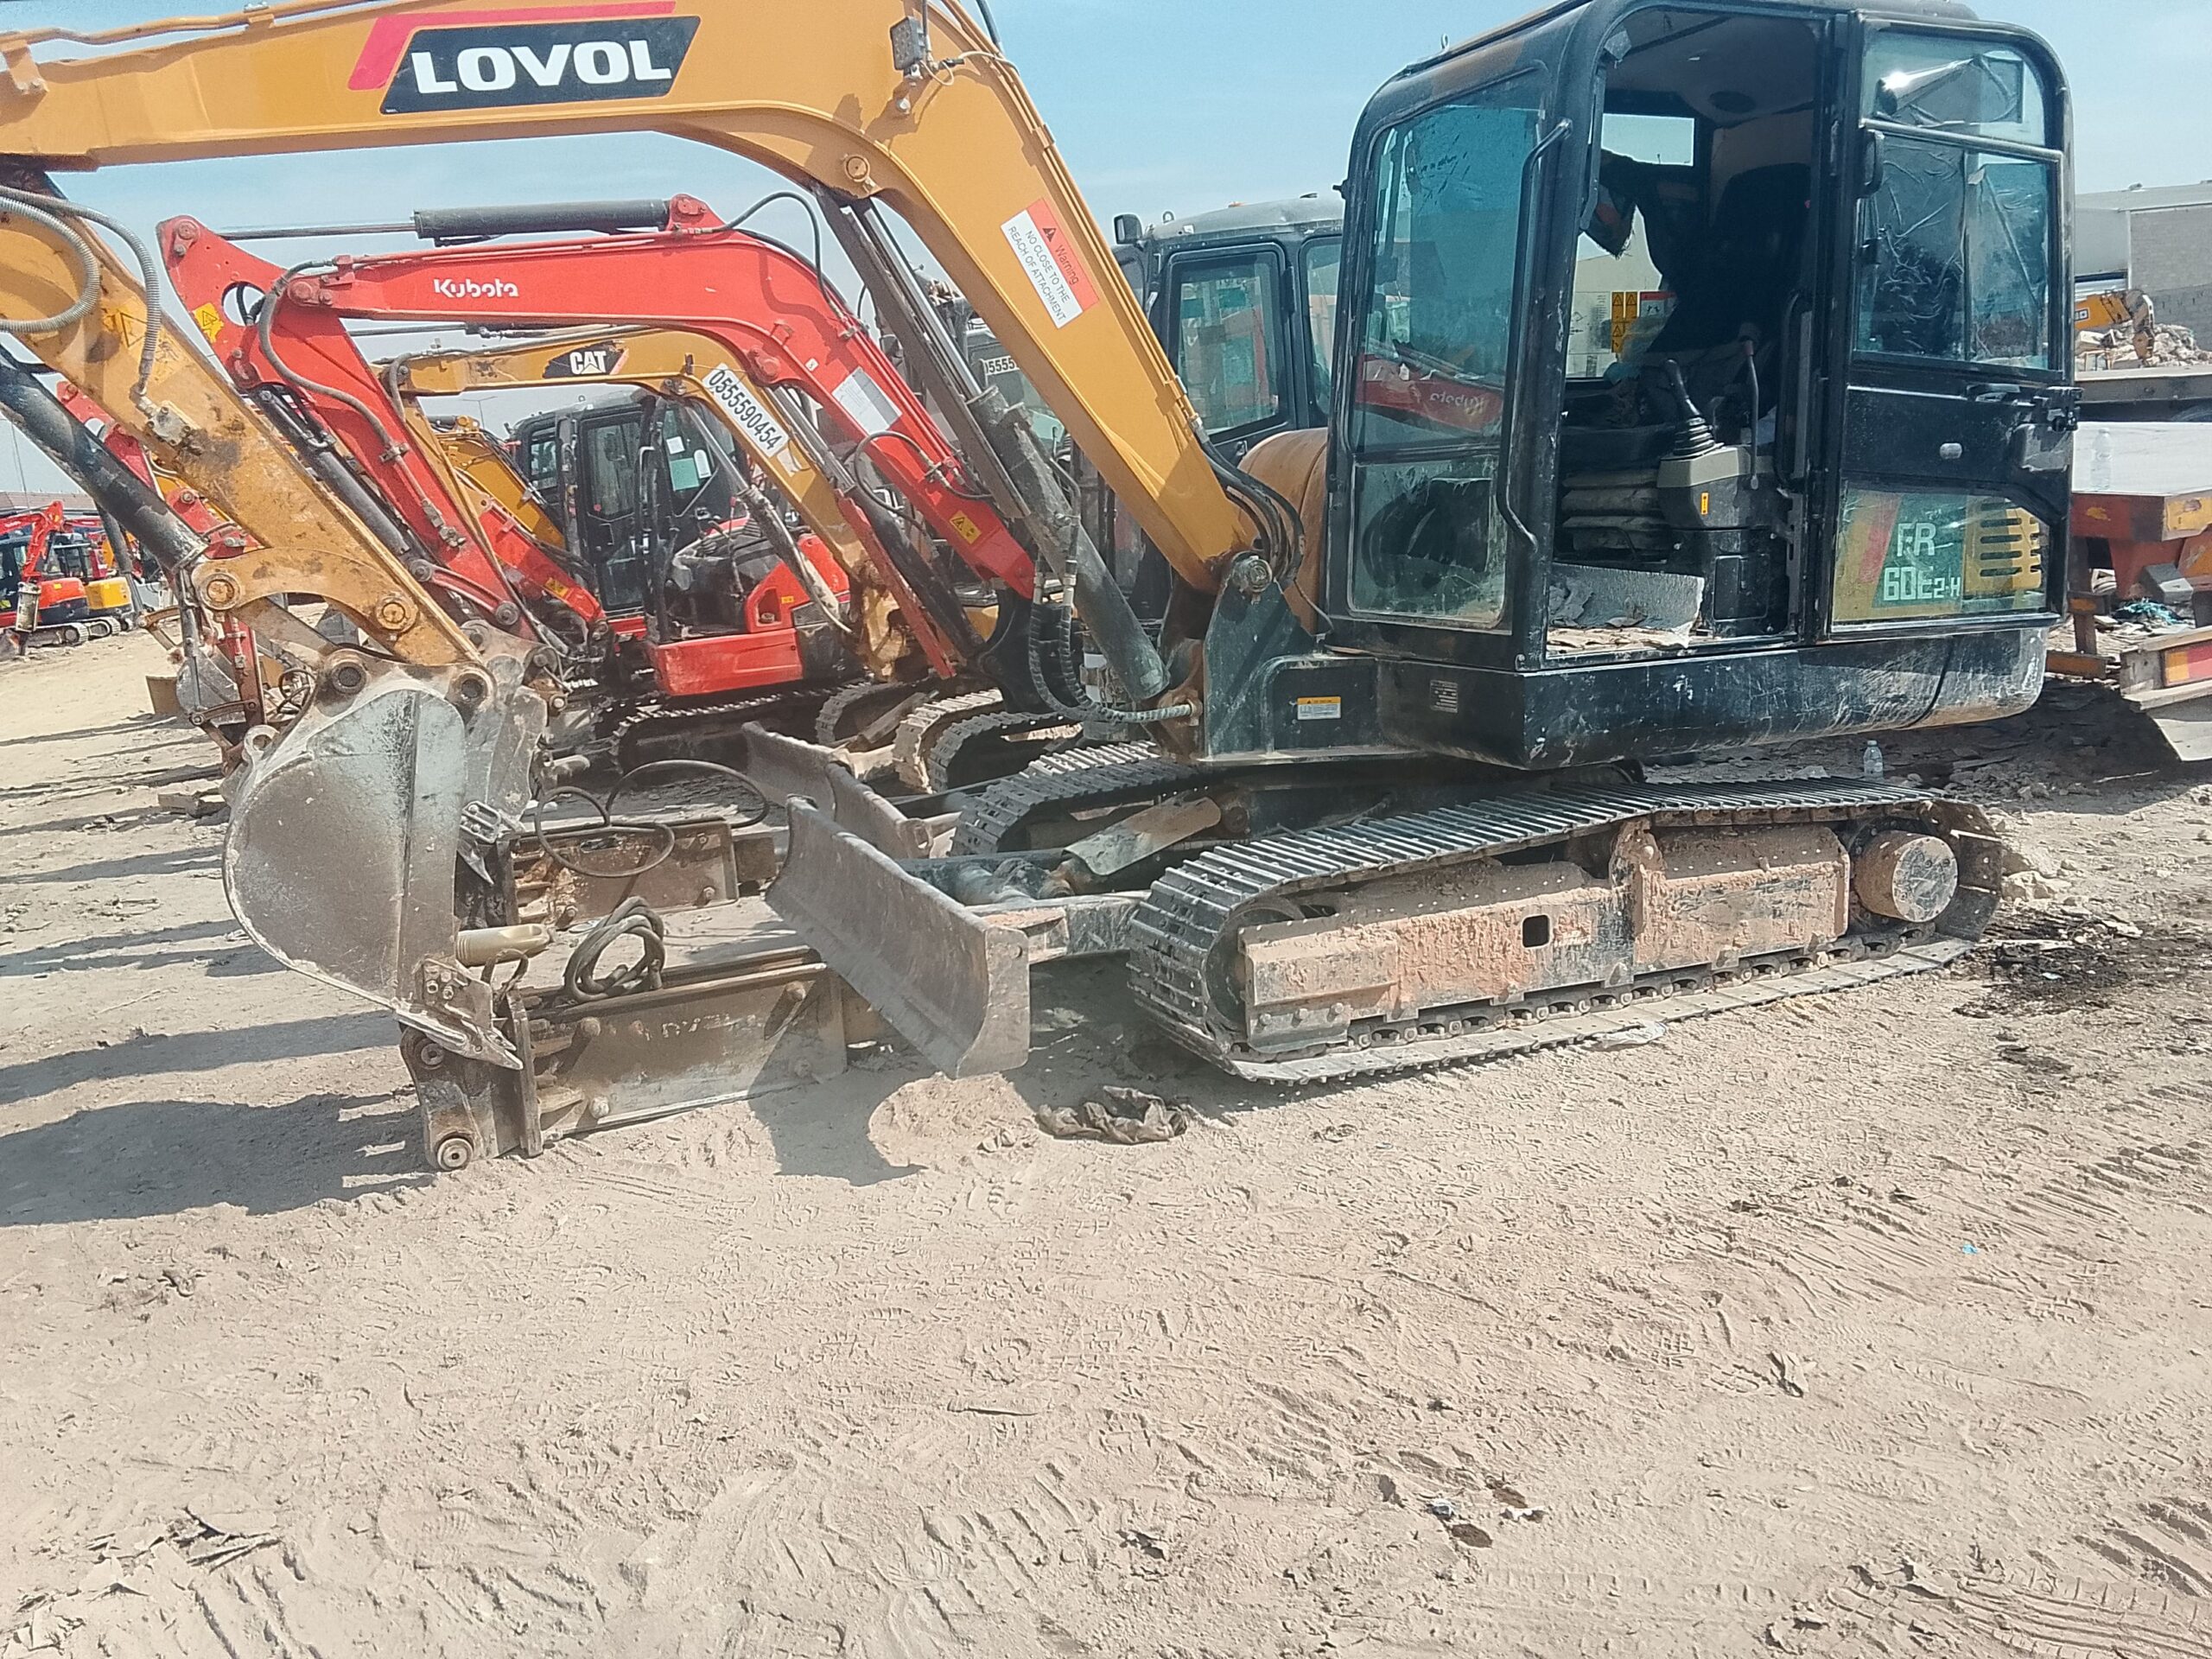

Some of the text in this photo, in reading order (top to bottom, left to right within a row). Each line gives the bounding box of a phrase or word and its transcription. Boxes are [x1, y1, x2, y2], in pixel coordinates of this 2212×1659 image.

[411, 40, 672, 93] LOVOL
[434, 278, 519, 298] Kubota
[1008, 226, 1066, 321] REACH OF ATTACHMENT
[1026, 230, 1071, 304] NO CLOSE TO THE
[1055, 245, 1079, 285] Warning
[569, 351, 607, 375] CAT
[709, 370, 782, 450] 0555590454
[1897, 522, 1936, 556] FR
